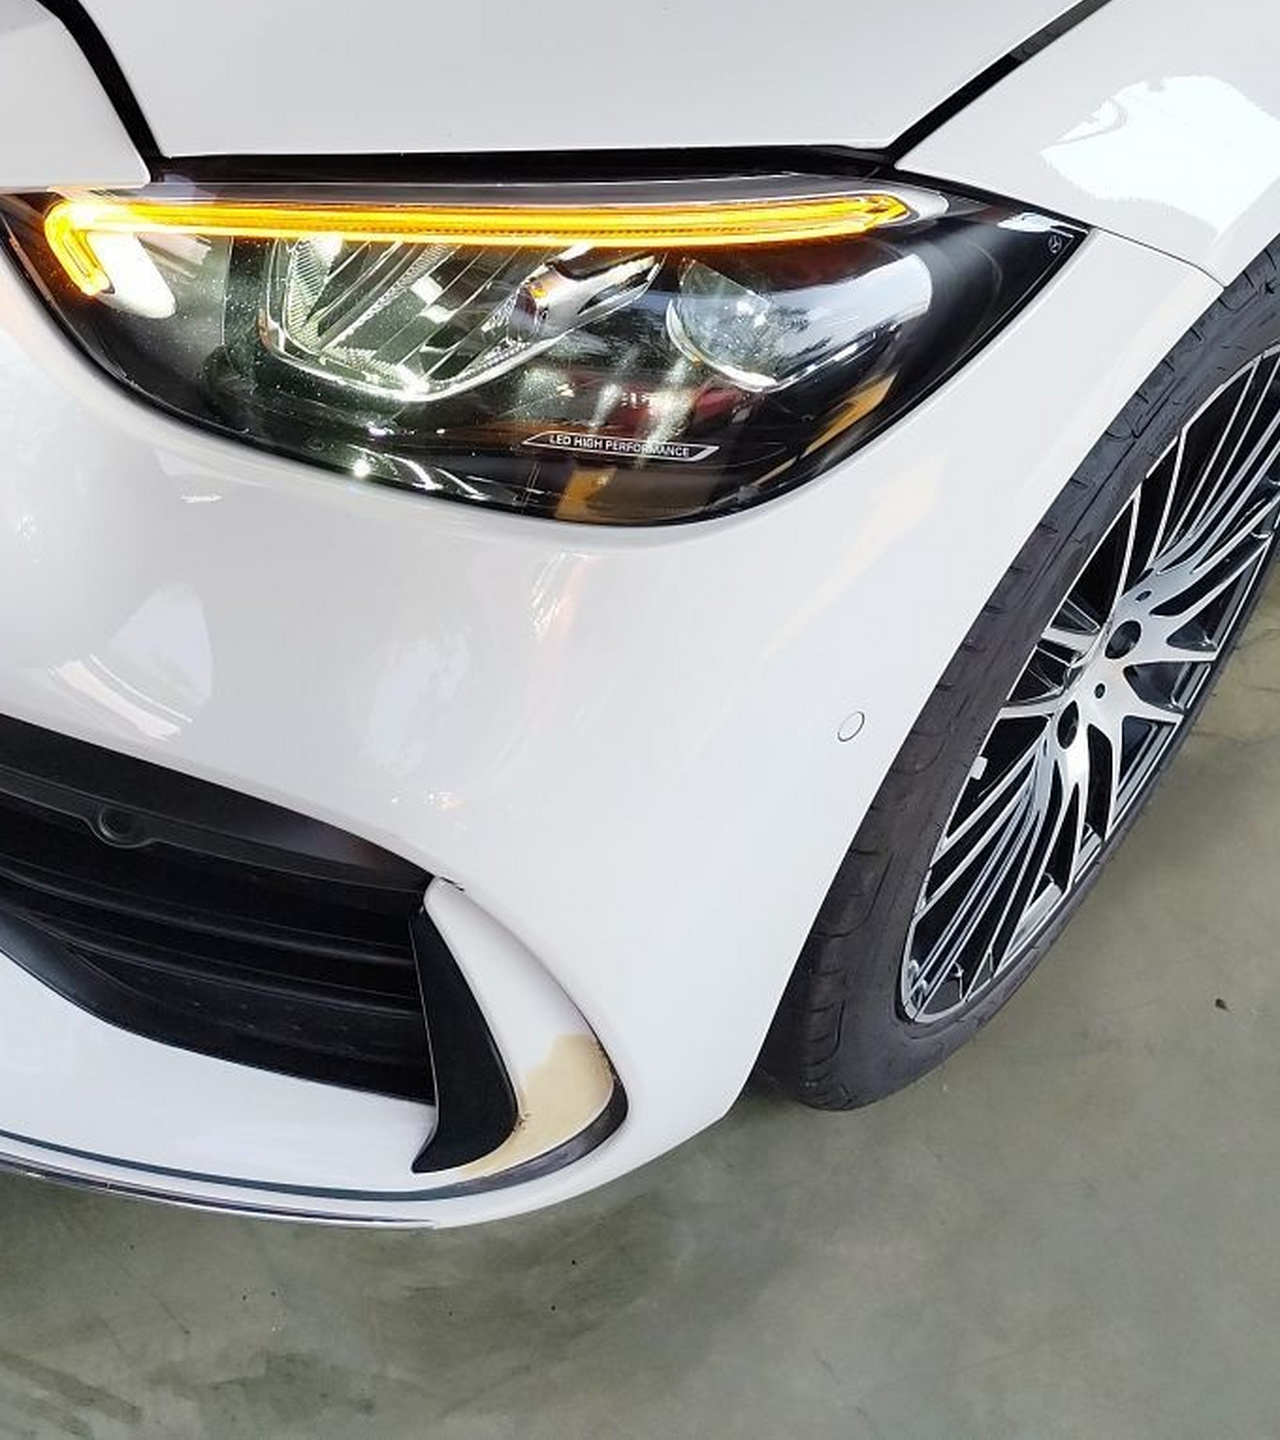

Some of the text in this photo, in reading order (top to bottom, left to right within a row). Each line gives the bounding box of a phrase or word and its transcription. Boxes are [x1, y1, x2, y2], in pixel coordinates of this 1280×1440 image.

[549, 433, 690, 457] LED HIGH PERFORMANCE
